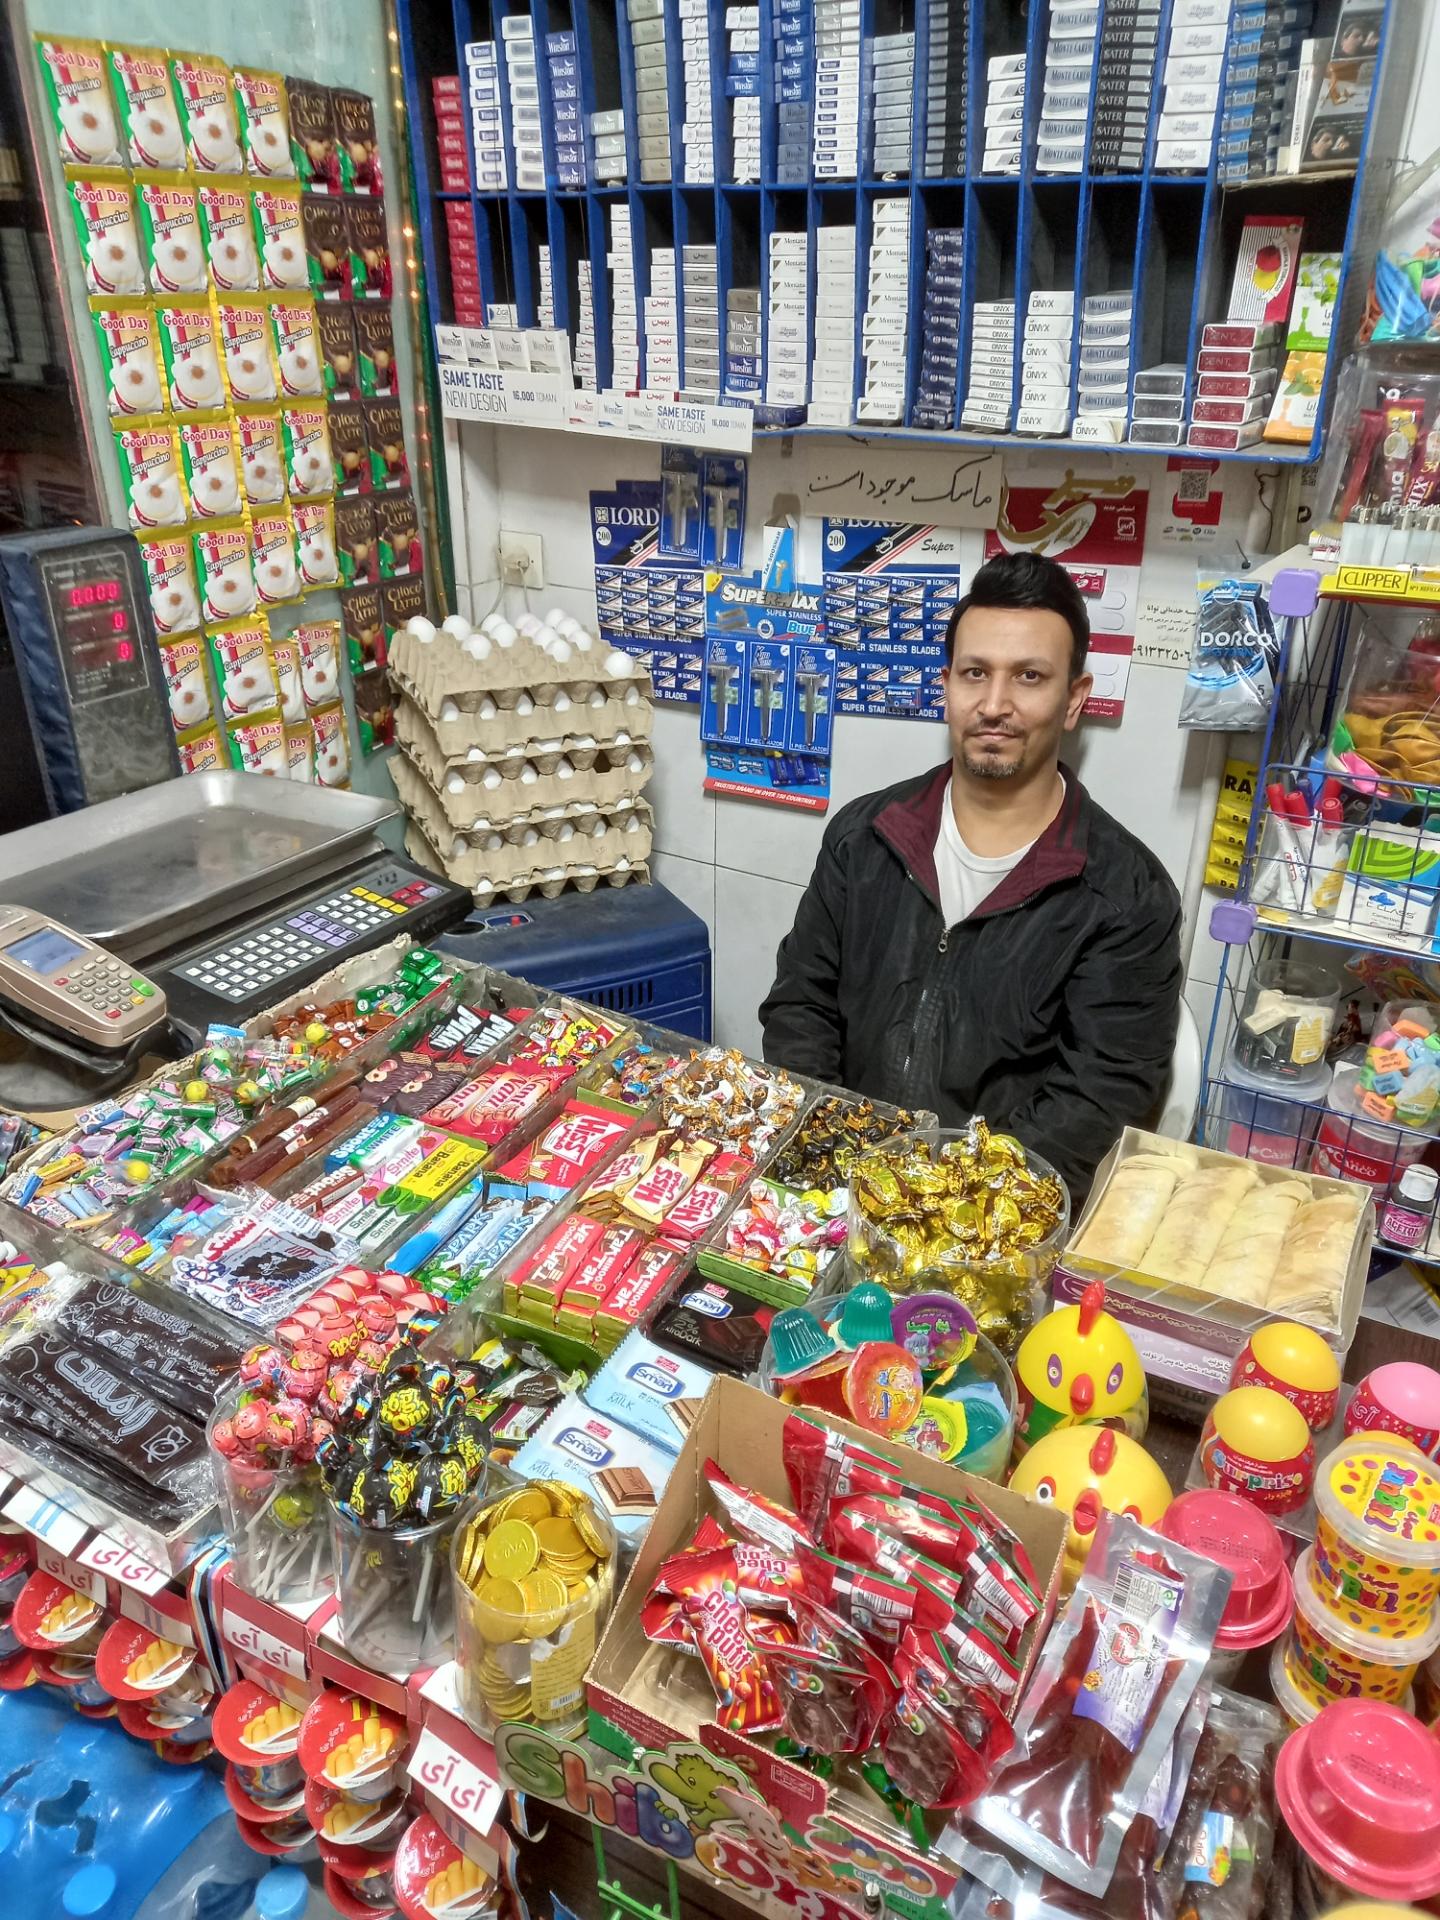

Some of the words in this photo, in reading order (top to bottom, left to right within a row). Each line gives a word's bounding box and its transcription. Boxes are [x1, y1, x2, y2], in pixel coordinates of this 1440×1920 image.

[549, 41, 570, 52] Winston
[42, 49, 74, 67] Good
[75, 53, 101, 71] Day
[553, 64, 574, 76] Winston
[56, 77, 101, 97] Cappuccino
[74, 188, 104, 202] Good
[105, 190, 129, 205] Day
[142, 191, 172, 205] Good
[174, 193, 195, 208] Day
[86, 211, 130, 232] Cappuccino
[153, 212, 194, 233] Cappuccino
[99, 317, 126, 330] Good
[128, 316, 150, 331] Day
[162, 314, 190, 328] Good
[191, 314, 211, 329] Day
[109, 337, 149, 357] Cappuccino
[172, 333, 211, 354] Cappuccino
[470, 339, 491, 349] Winston
[443, 369, 471, 388] SAME
[473, 373, 504, 391] TASTE
[445, 390, 467, 408] NEW
[469, 393, 507, 412] DESIGN
[284, 414, 305, 426] Good
[305, 413, 323, 426] Day
[658, 405, 679, 418] SAME
[682, 409, 705, 420] TASTE
[657, 418, 675, 431] NEW
[677, 420, 706, 434] DESIGN
[293, 429, 322, 449] Cappuccino
[869, 475, 916, 505] موجود
[912, 455, 992, 509] ماسک
[612, 507, 659, 527] LORD
[597, 531, 610, 543] 200
[829, 536, 845, 547] 200
[921, 537, 955, 553] Super
[142, 549, 168, 562] Good
[168, 542, 186, 557] Day
[150, 562, 186, 584] Cappuccino
[897, 579, 915, 587] LORD
[1344, 570, 1402, 590] CLIPPER
[115, 612, 123, 629] 0
[766, 608, 786, 618] SUPER
[789, 611, 822, 621] STAINLESS
[787, 620, 817, 635] BLUE
[869, 643, 907, 654] STAINLESS
[911, 646, 941, 655] BLADES
[1200, 631, 1273, 648] DORCO
[120, 642, 129, 659] 0
[664, 690, 688, 701] BLADES
[1258, 684, 1265, 696] 5
[842, 702, 865, 712] SUPER
[868, 704, 907, 716] STAINLESS
[909, 707, 938, 718] BLADES
[714, 781, 736, 790] TRUSTED
[736, 785, 754, 793] BRAND
[762, 790, 776, 798] OVER
[786, 794, 816, 805] COUNTRIES
[430, 1005, 481, 1049] MAKI
[463, 1014, 514, 1055] MAKI
[452, 1074, 494, 1108] Nani
[488, 1073, 528, 1108] Nani
[367, 1125, 401, 1151] WHITE
[570, 1115, 613, 1166] Hiss
[387, 1147, 420, 1176] Smile
[414, 1150, 451, 1178] Banana
[434, 1160, 470, 1189] Banana
[591, 1155, 635, 1190] Hiss
[633, 1165, 676, 1206] Hiss
[325, 1197, 359, 1225] Smile
[671, 1185, 712, 1223] Hiss
[349, 1208, 376, 1230] Smile
[370, 1217, 396, 1239] Smile
[473, 1214, 534, 1270] SPARK
[689, 1294, 722, 1313] Smart
[634, 1368, 675, 1394] Smart
[607, 1394, 634, 1412] MILK
[562, 1432, 603, 1460] Smart
[528, 1462, 557, 1480] MILK
[1211, 1448, 1304, 1491] Surprise
[421, 1755, 461, 1789] آی
[450, 1779, 494, 1814] آی
